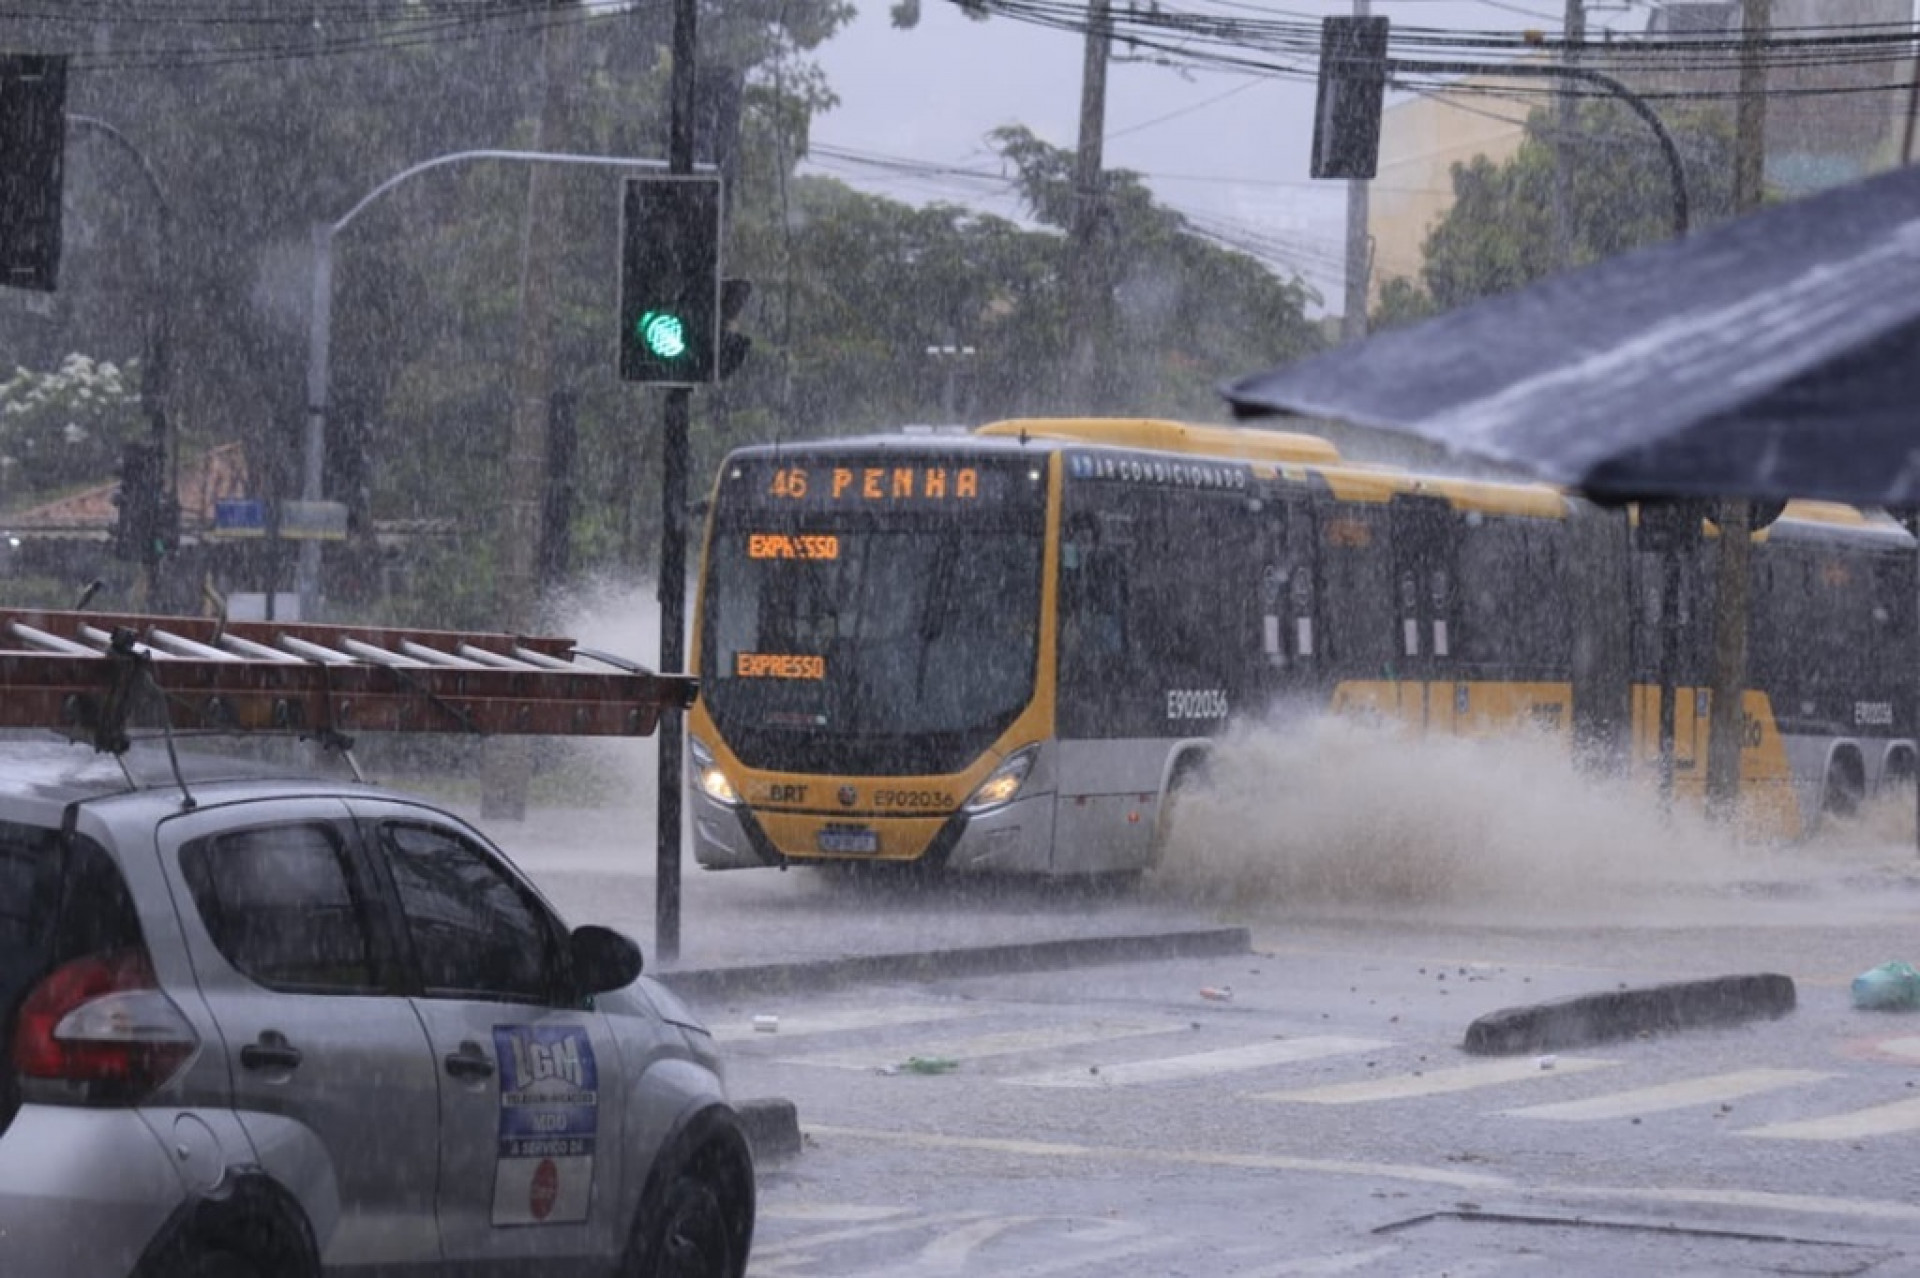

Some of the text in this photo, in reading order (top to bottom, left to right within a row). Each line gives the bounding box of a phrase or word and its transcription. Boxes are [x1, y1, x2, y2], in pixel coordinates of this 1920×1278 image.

[832, 467, 979, 498] PENHA
[737, 653, 825, 680] EXPRESSO
[1167, 689, 1228, 719] E902036
[770, 784, 808, 802] BRT
[874, 788, 955, 808] E902036
[511, 1035, 583, 1090] LGM
